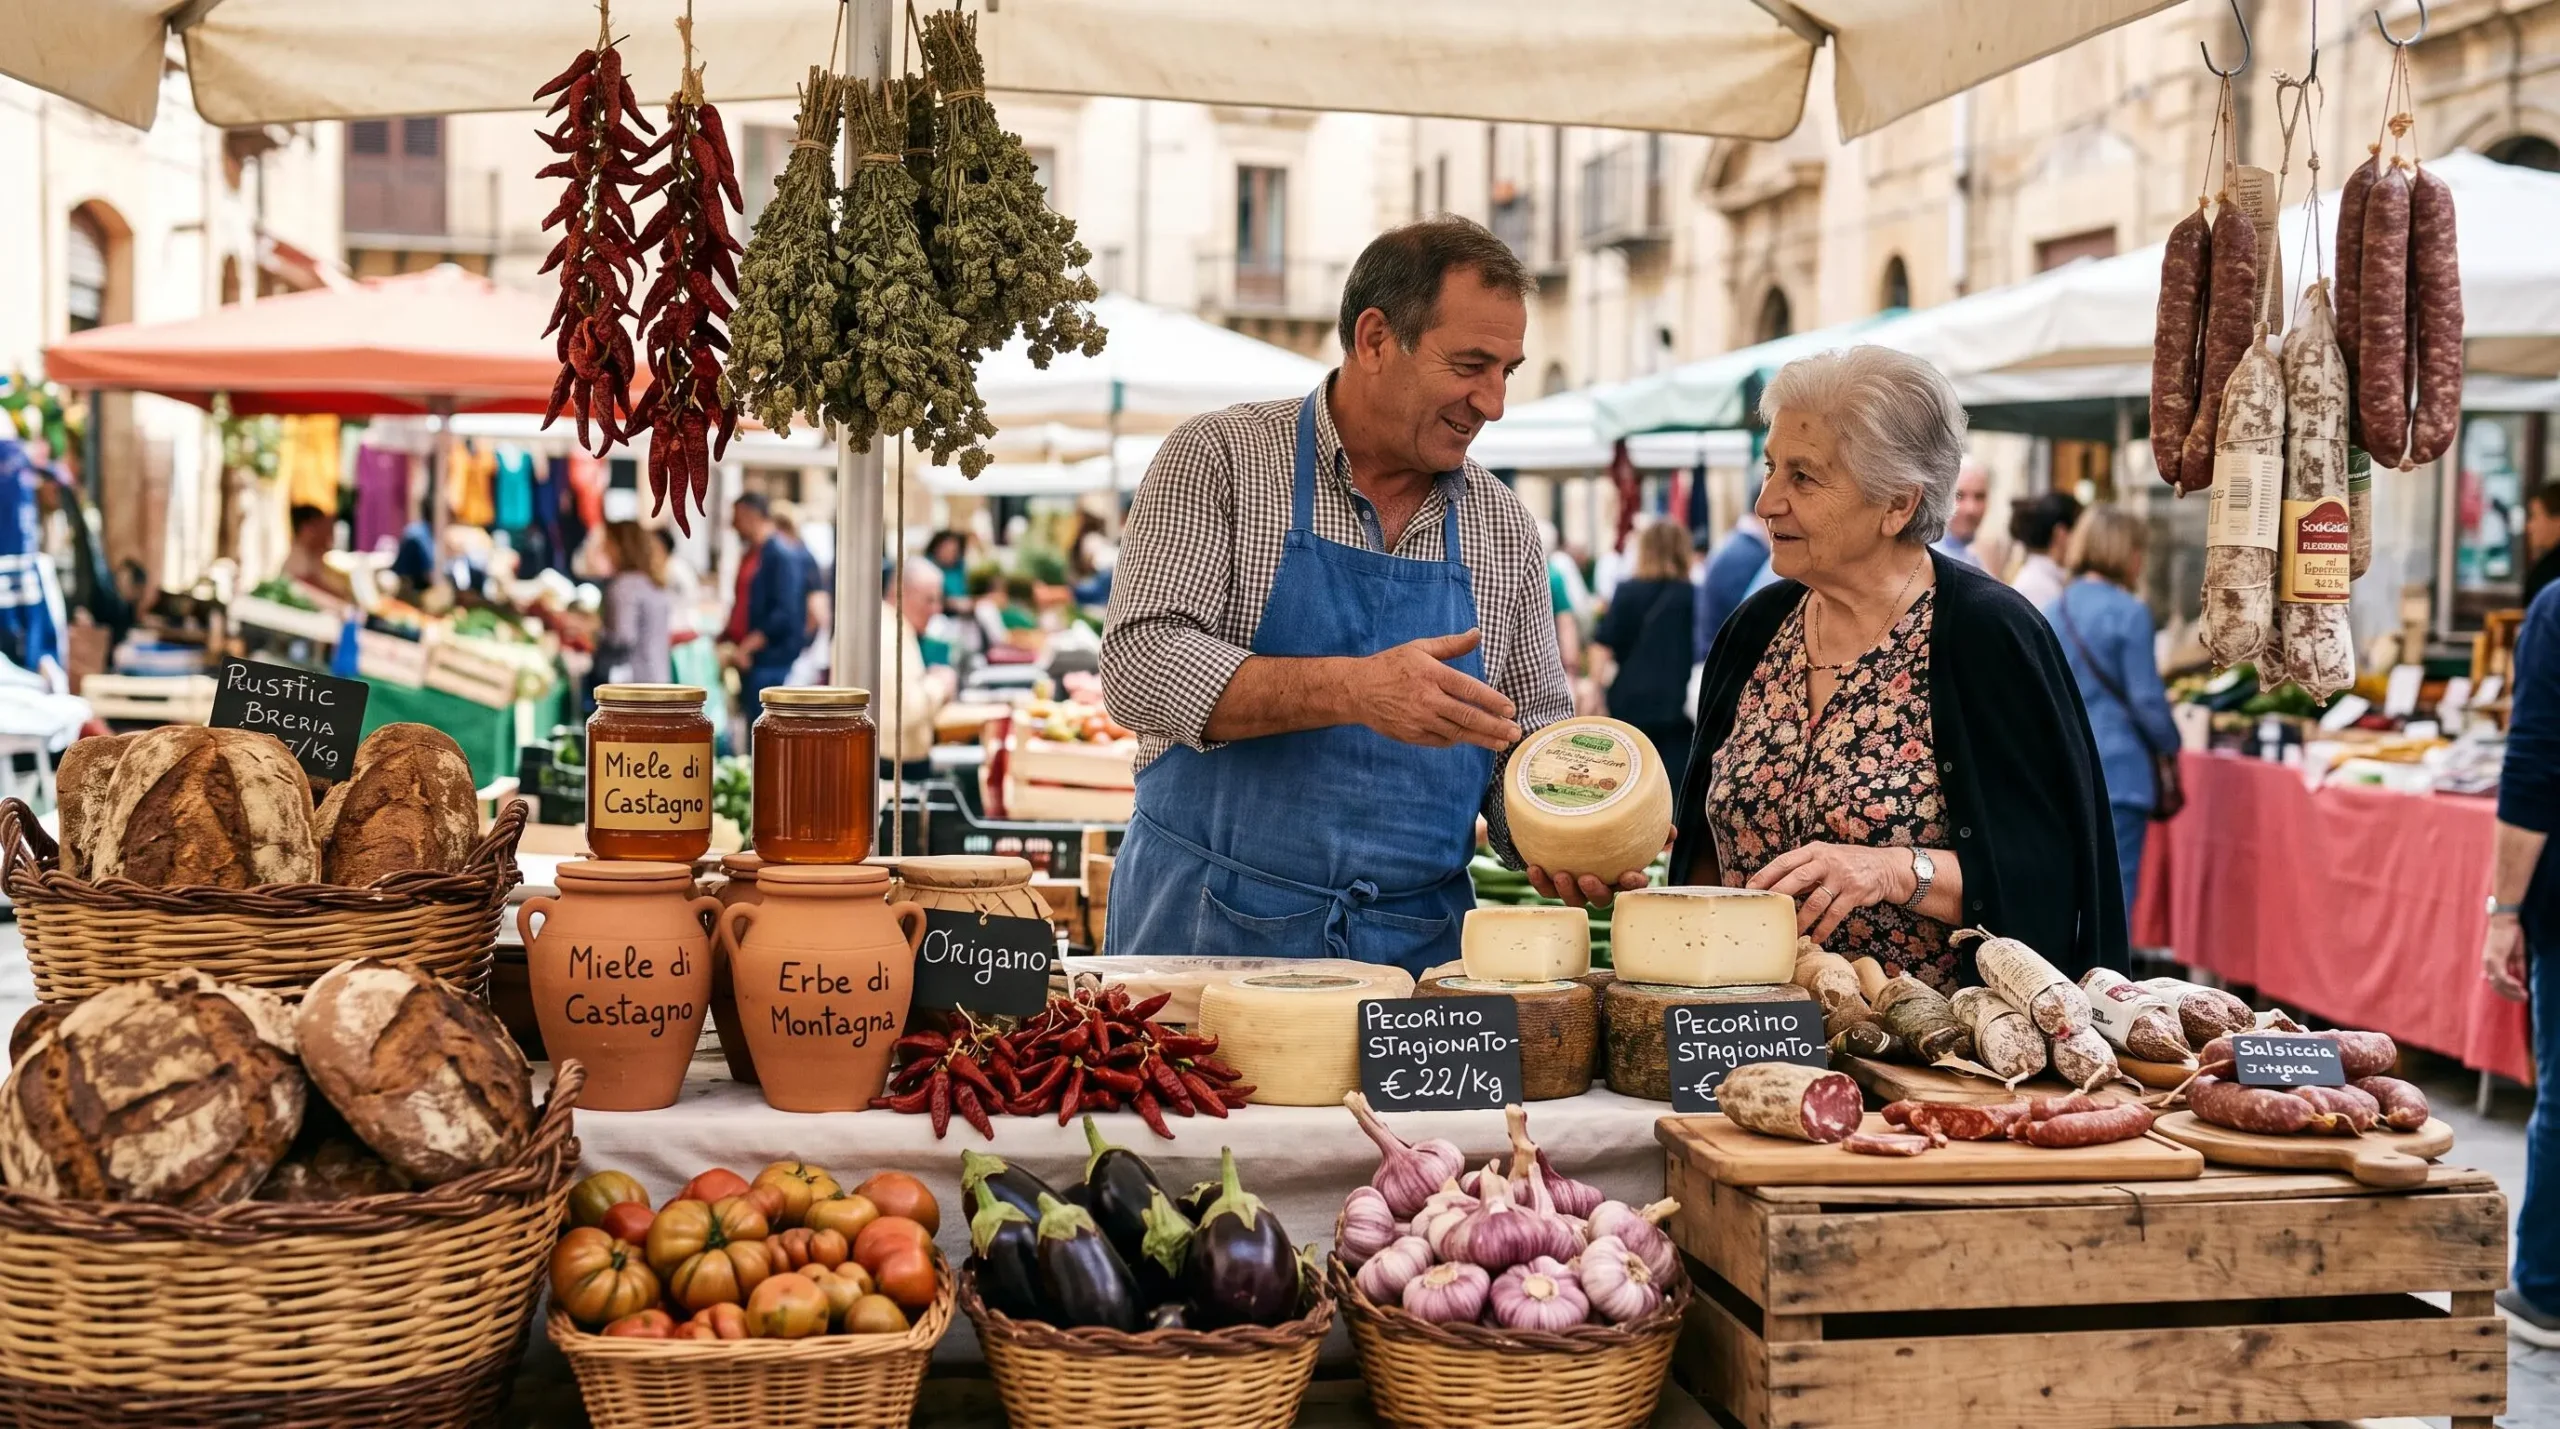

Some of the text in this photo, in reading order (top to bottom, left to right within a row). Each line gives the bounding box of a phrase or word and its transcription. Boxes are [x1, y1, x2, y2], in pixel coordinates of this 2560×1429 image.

[605, 751, 699, 780] Miele di
[604, 788, 704, 825] Castagno
[569, 945, 690, 980] Miele di
[779, 961, 889, 994] Erbe di
[565, 993, 693, 1037] Castagno
[771, 1005, 896, 1048] Montagna
[2239, 1040, 2335, 1058] Salsiccia
